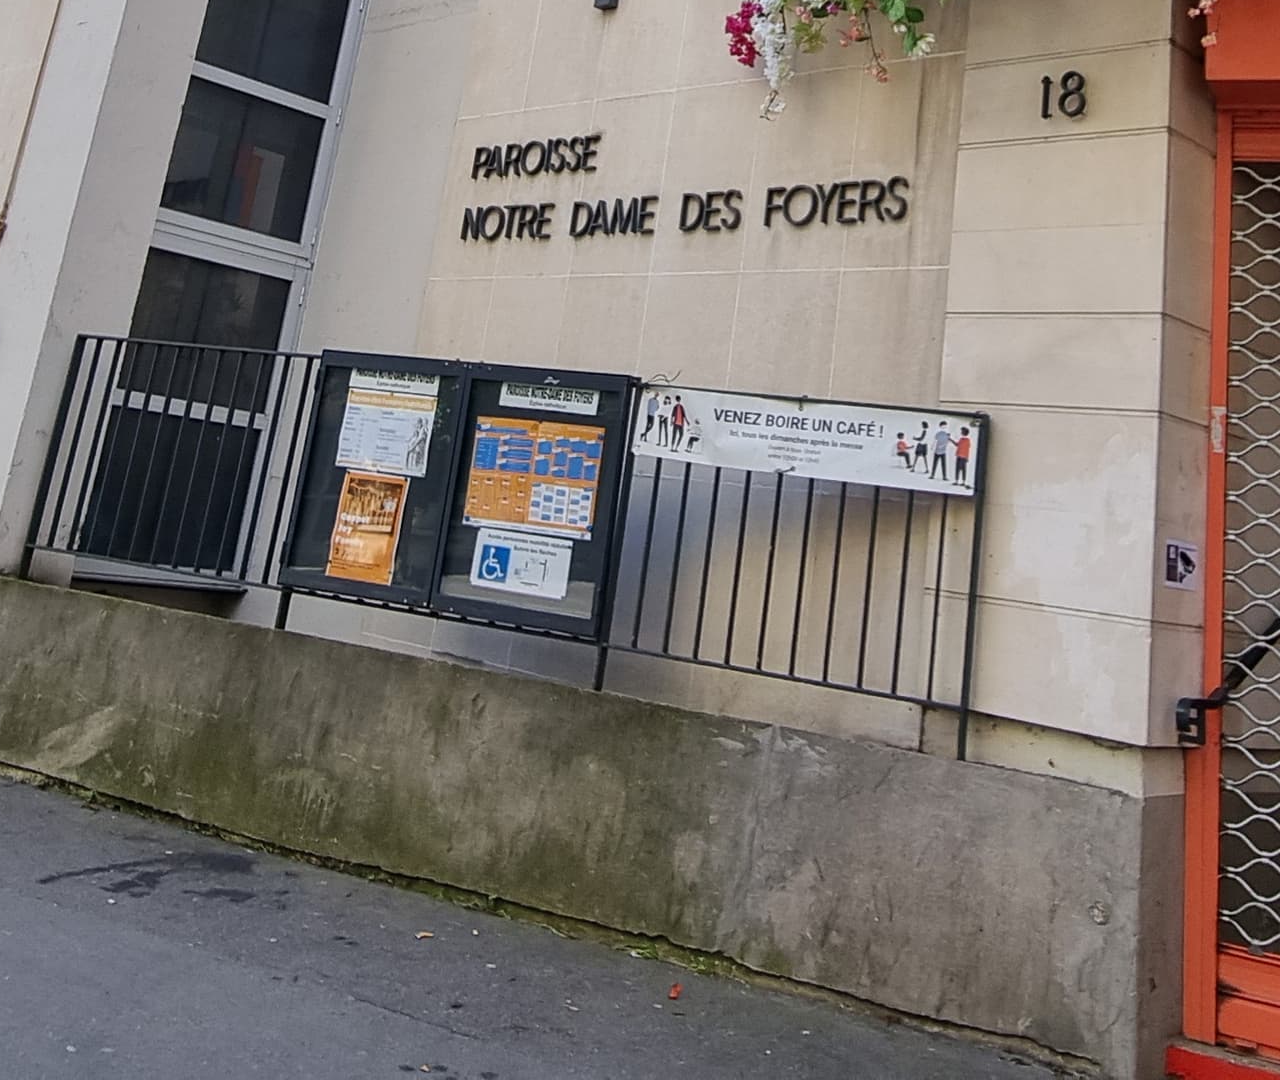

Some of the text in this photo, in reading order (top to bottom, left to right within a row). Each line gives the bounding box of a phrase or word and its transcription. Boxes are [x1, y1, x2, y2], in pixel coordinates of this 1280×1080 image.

[1040, 70, 1088, 120] 18
[471, 134, 601, 180] PAROISSE
[460, 175, 910, 242] NOTRE DAME DES FOYERS
[713, 407, 762, 426] VENEZ
[765, 413, 809, 431] BOIRE
[812, 418, 833, 433] UN
[836, 420, 875, 438] CAFÉ
[741, 431, 757, 439] tous
[758, 432, 769, 441] les
[770, 433, 809, 445] dimanches
[810, 438, 830, 448] après
